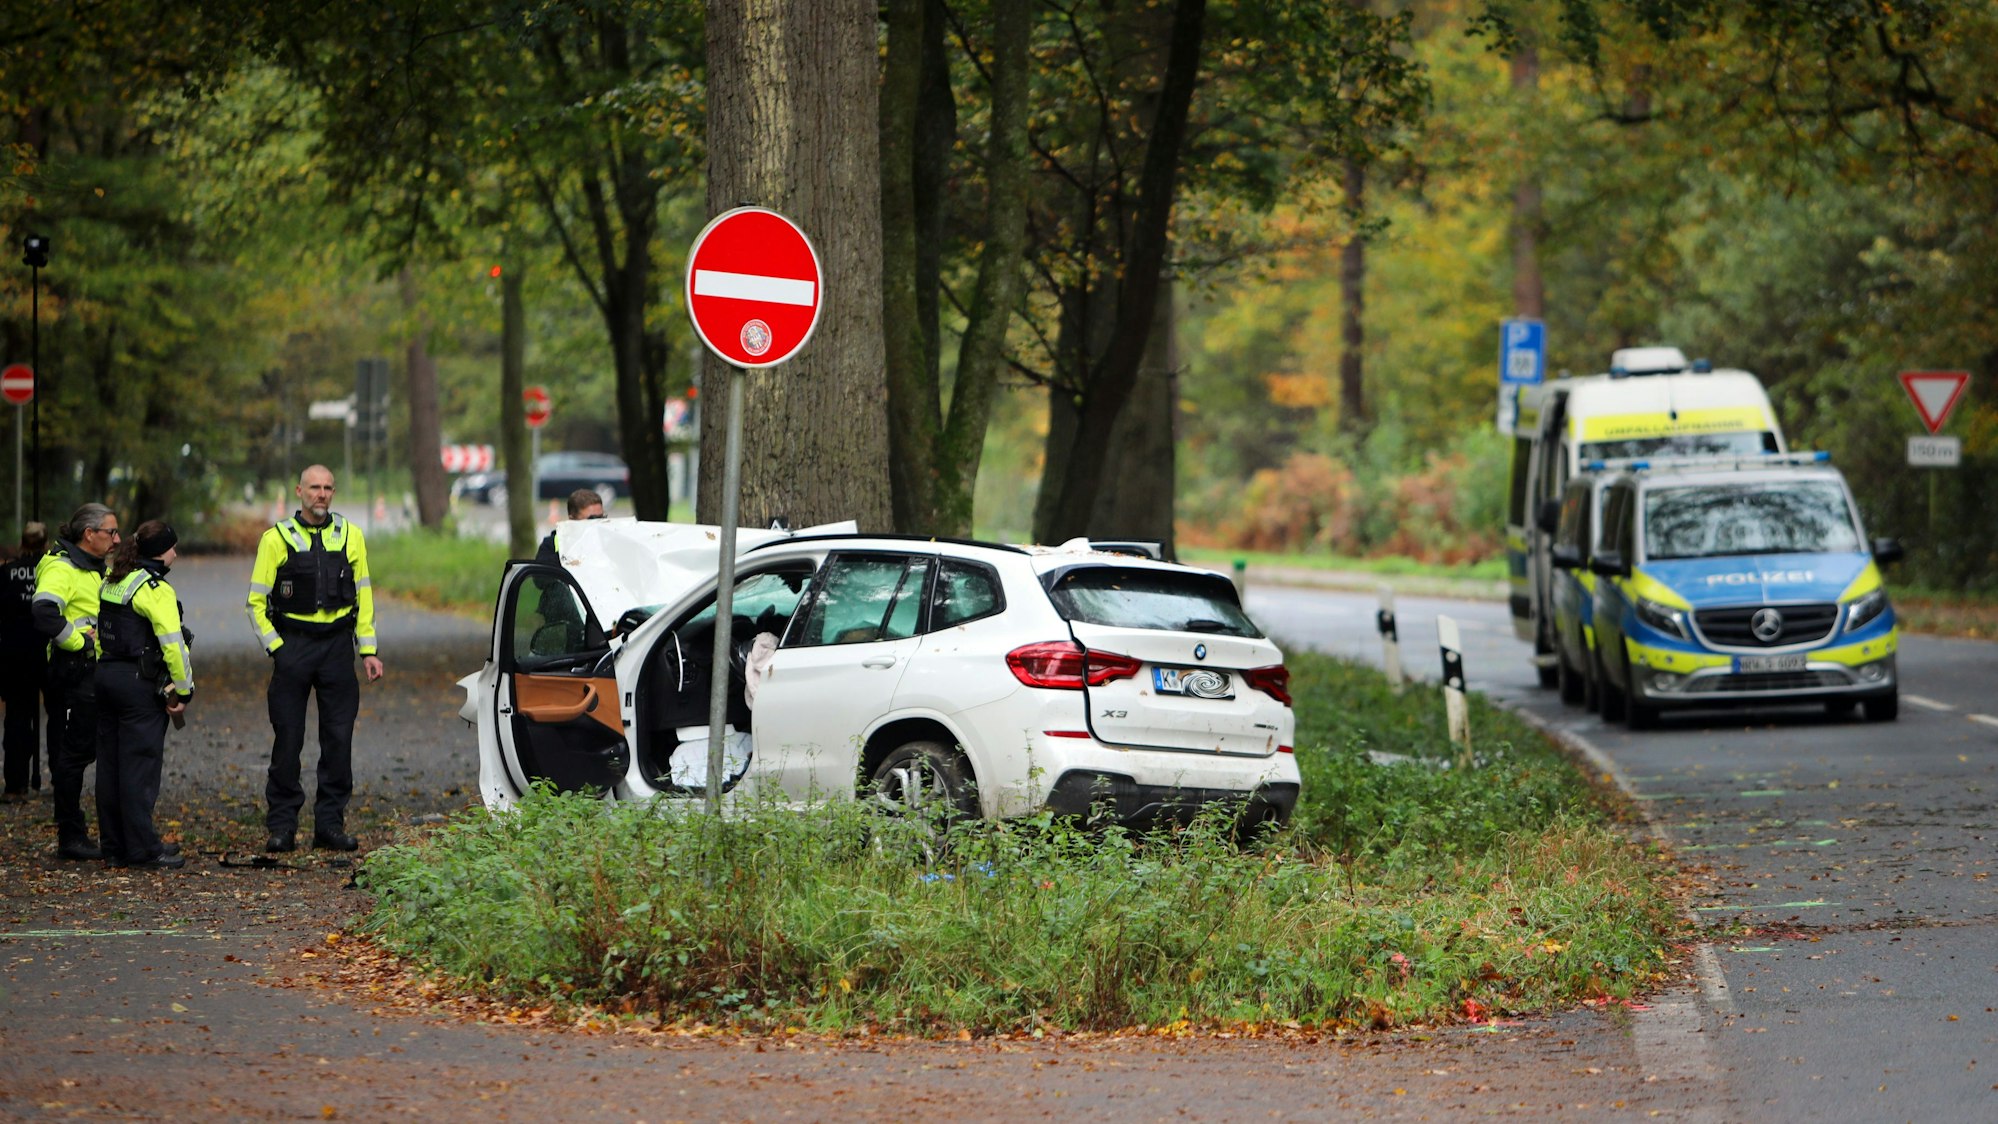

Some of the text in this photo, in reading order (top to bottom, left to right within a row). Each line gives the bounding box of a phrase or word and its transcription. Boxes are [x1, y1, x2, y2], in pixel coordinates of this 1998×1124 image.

[1507, 322, 1531, 349] P
[10, 567, 36, 580] POLI
[1706, 570, 1814, 586] POLIZEI
[1162, 671, 1171, 688] K
[1101, 709, 1128, 718] X3
